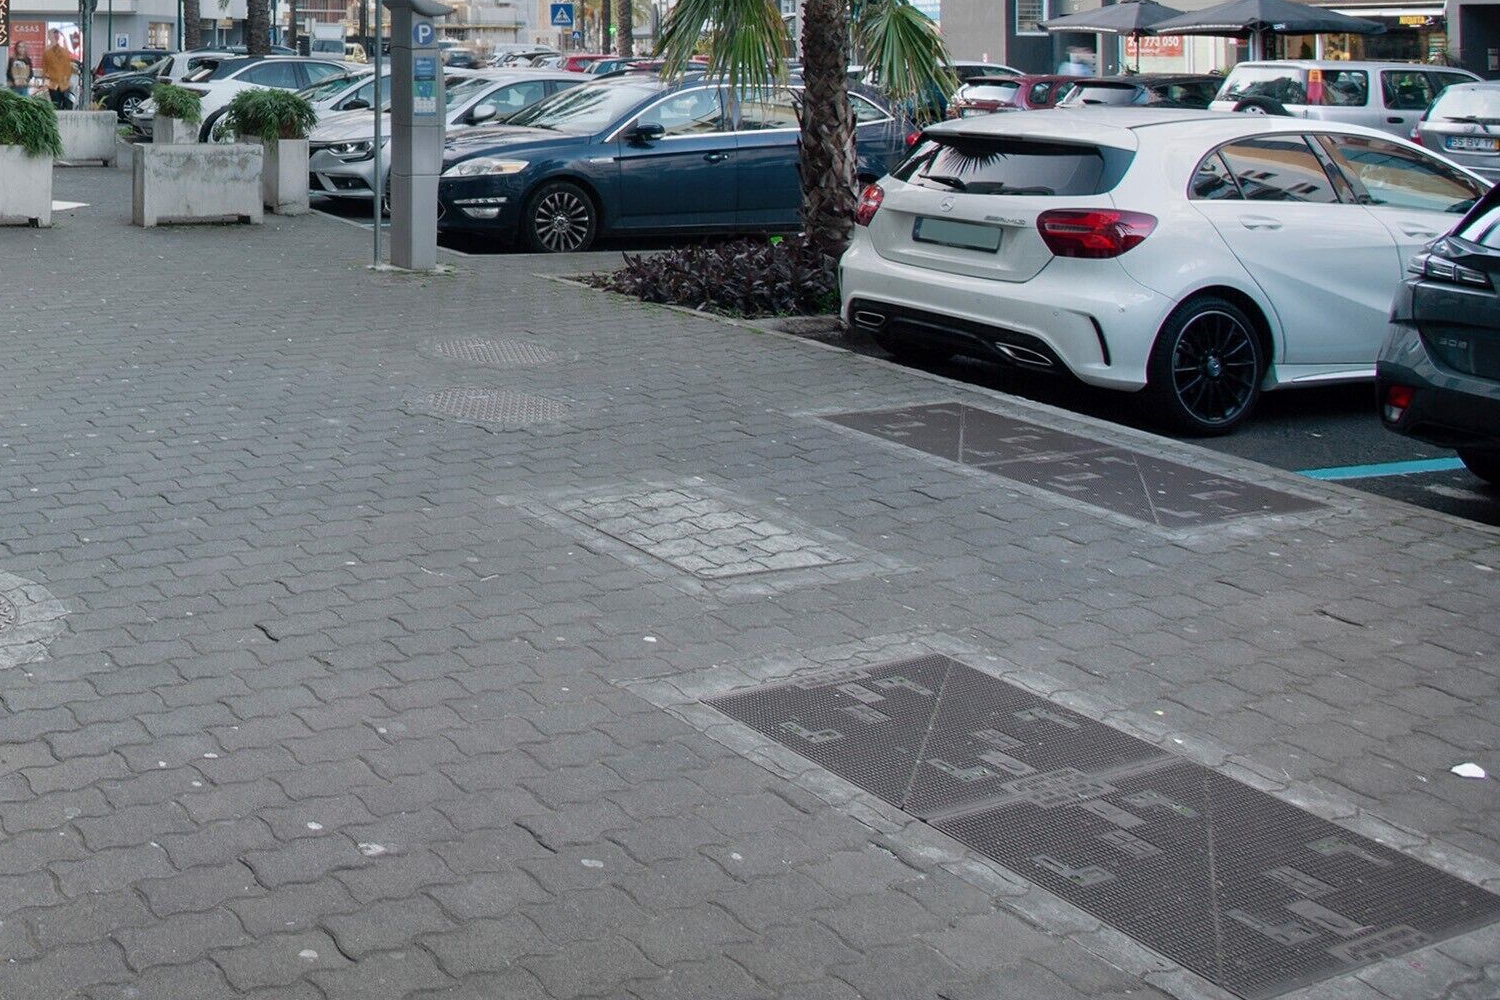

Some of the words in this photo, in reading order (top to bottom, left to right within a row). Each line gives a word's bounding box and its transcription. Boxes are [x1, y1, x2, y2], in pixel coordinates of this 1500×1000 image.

[14, 25, 40, 33] CASAS
[418, 24, 432, 44] P
[1144, 36, 1160, 47] 773
[1162, 36, 1179, 47] 050
